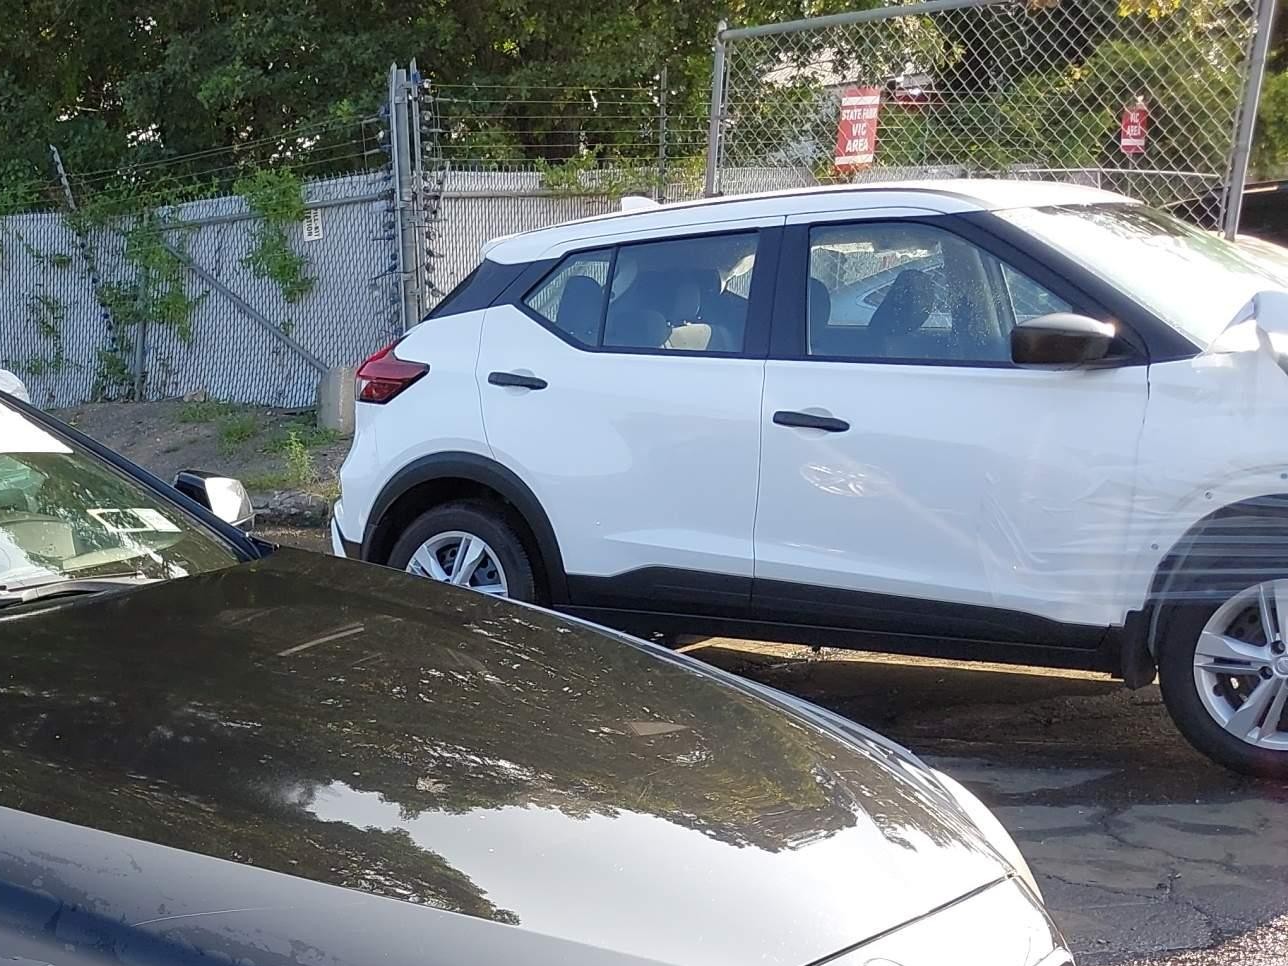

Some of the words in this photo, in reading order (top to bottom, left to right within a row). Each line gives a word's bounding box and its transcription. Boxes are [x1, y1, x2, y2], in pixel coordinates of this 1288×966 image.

[841, 109, 862, 120] STATE
[852, 122, 867, 136] VIC
[845, 138, 869, 153] AREA
